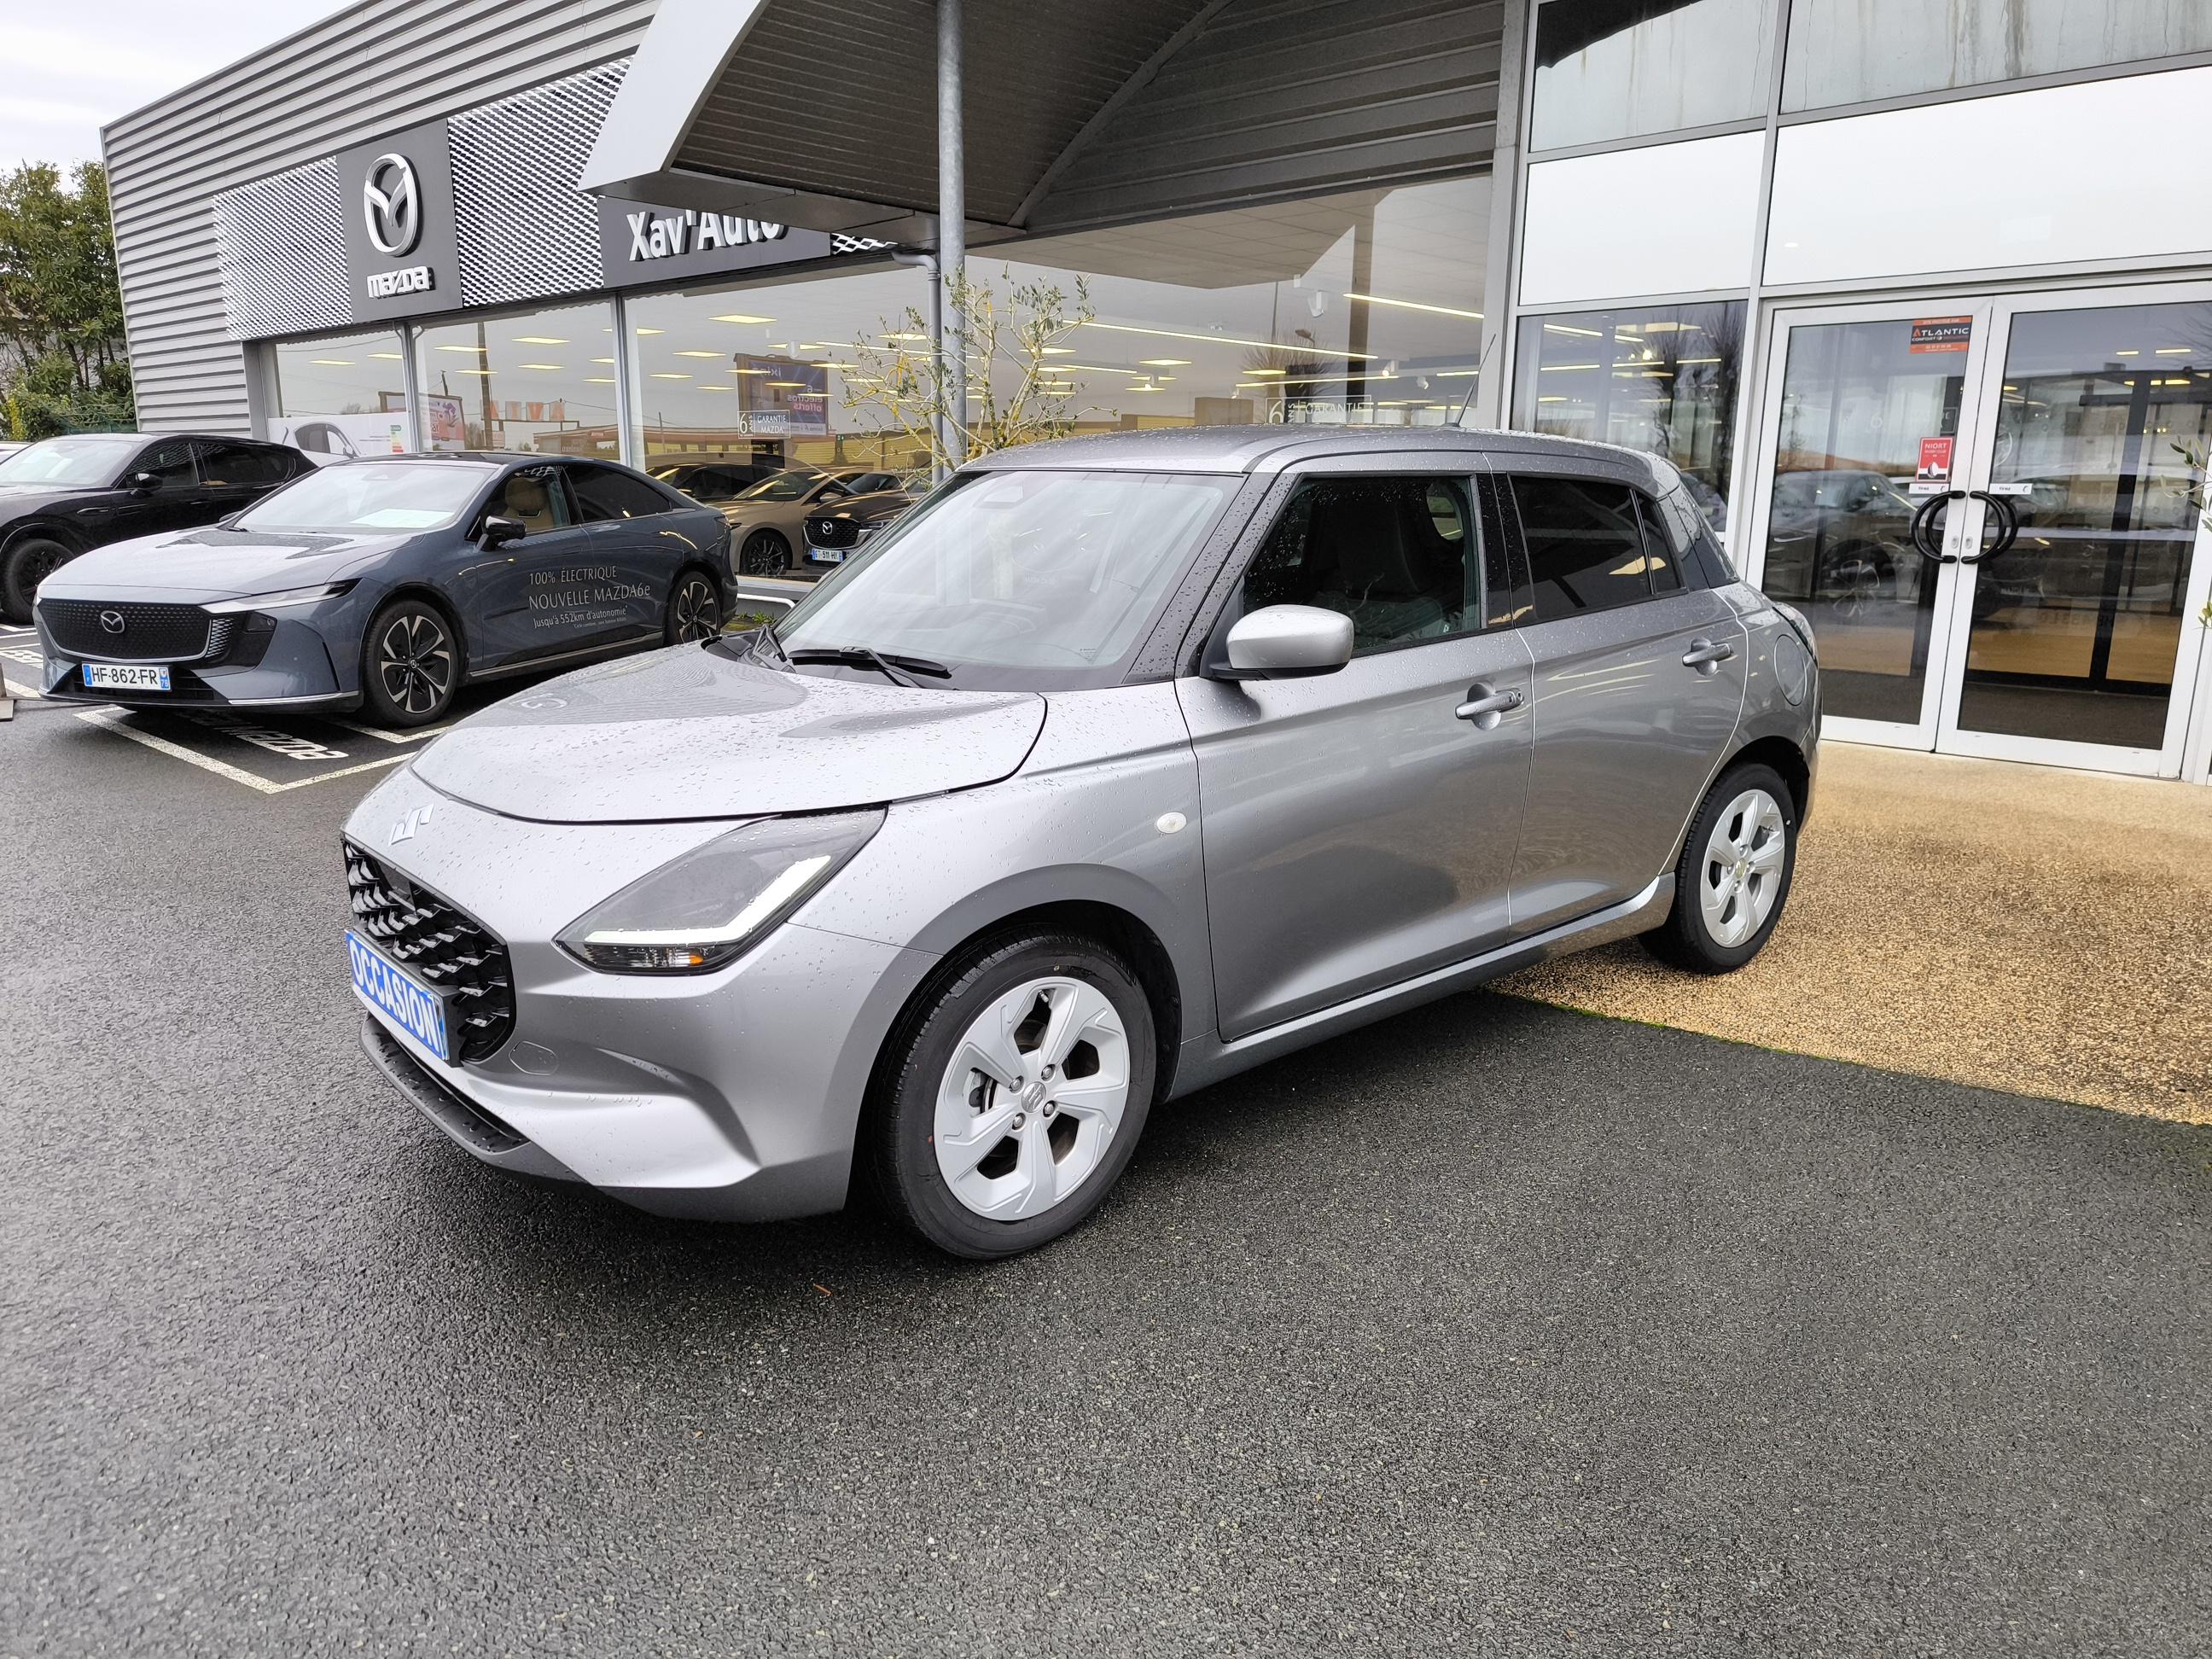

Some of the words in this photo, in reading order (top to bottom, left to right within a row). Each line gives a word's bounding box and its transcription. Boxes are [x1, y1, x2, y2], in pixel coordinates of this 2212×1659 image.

[1912, 328, 1969, 338] ATLANTIC
[1269, 400, 1284, 424] 6
[1306, 403, 1362, 415] GARANTIE
[739, 413, 748, 434] 6
[757, 415, 786, 423] GARANTIE
[760, 425, 784, 434] MAZDA
[529, 571, 556, 585] 100%
[561, 565, 617, 582] ÉLECTRIQUE
[528, 590, 590, 610] NOUVELLE
[594, 583, 650, 602] MAZDA6e
[533, 615, 559, 628] Jusqu'à
[561, 612, 585, 625] 552km
[91, 667, 158, 685] HF-862-FR
[349, 939, 440, 1053] OCCASION
